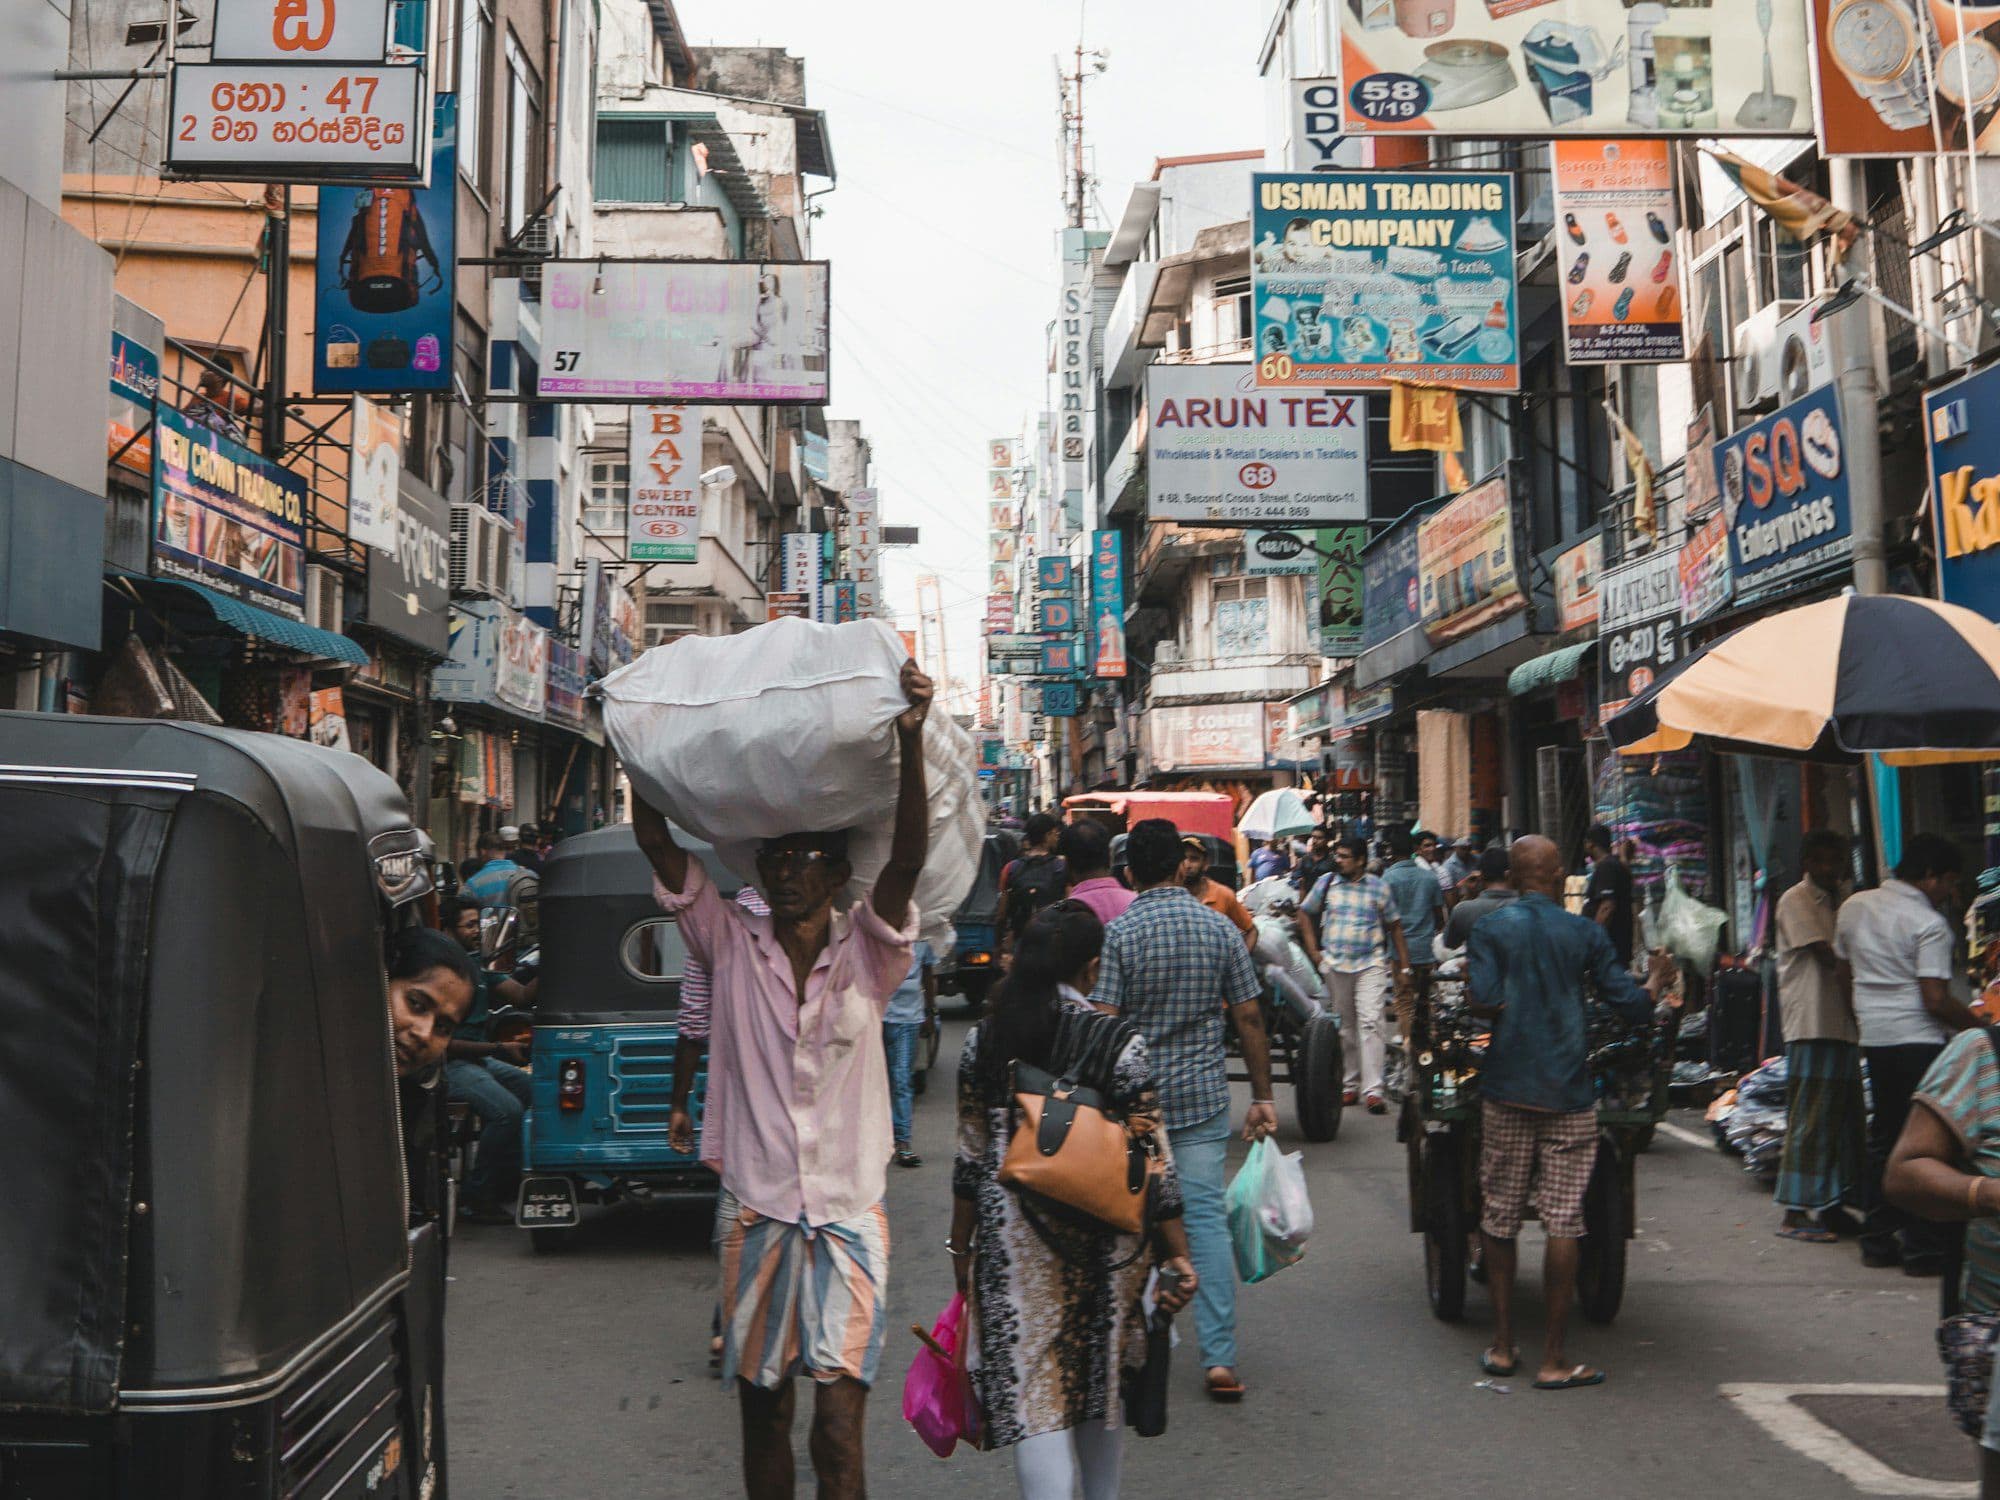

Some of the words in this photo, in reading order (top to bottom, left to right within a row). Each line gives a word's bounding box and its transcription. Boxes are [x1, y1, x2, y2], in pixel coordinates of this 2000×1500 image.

[326, 77, 379, 114] 47
[1362, 80, 1420, 101] 58
[1363, 101, 1416, 117] 1/19
[179, 115, 197, 142] 2
[211, 115, 257, 142] වන
[1260, 182, 1367, 211] USMAN
[1372, 182, 1503, 212] TRADING
[1310, 219, 1455, 247] COMPANY
[554, 351, 581, 372] 57
[1063, 288, 1082, 434] Suguna
[1155, 398, 1268, 428] ARUN
[1280, 398, 1356, 427] TEX
[1154, 449, 1210, 460] Wholesale
[1213, 449, 1222, 460] &
[1225, 449, 1256, 460] Retail
[1259, 449, 1299, 460] Dealers
[1303, 449, 1313, 460] in
[1316, 449, 1358, 460] Textiles
[1744, 417, 1807, 509] SQ
[160, 424, 190, 472] NEW
[191, 443, 236, 494] CROWN
[237, 464, 284, 517] TRADING
[1243, 466, 1274, 486] 68
[638, 489, 692, 501] SWEET
[1184, 492, 1223, 503] Second
[1226, 492, 1254, 503] Cross
[632, 504, 697, 517] CENTRE
[992, 444, 1010, 585] RAMYA
[650, 524, 679, 535] 63
[1736, 496, 1836, 565] Enterprises
[856, 511, 874, 582] FIVE
[1042, 562, 1069, 669] JDM
[1050, 690, 1069, 709] 92
[1339, 761, 1372, 785] 70
[523, 1203, 572, 1218] RE-SP
